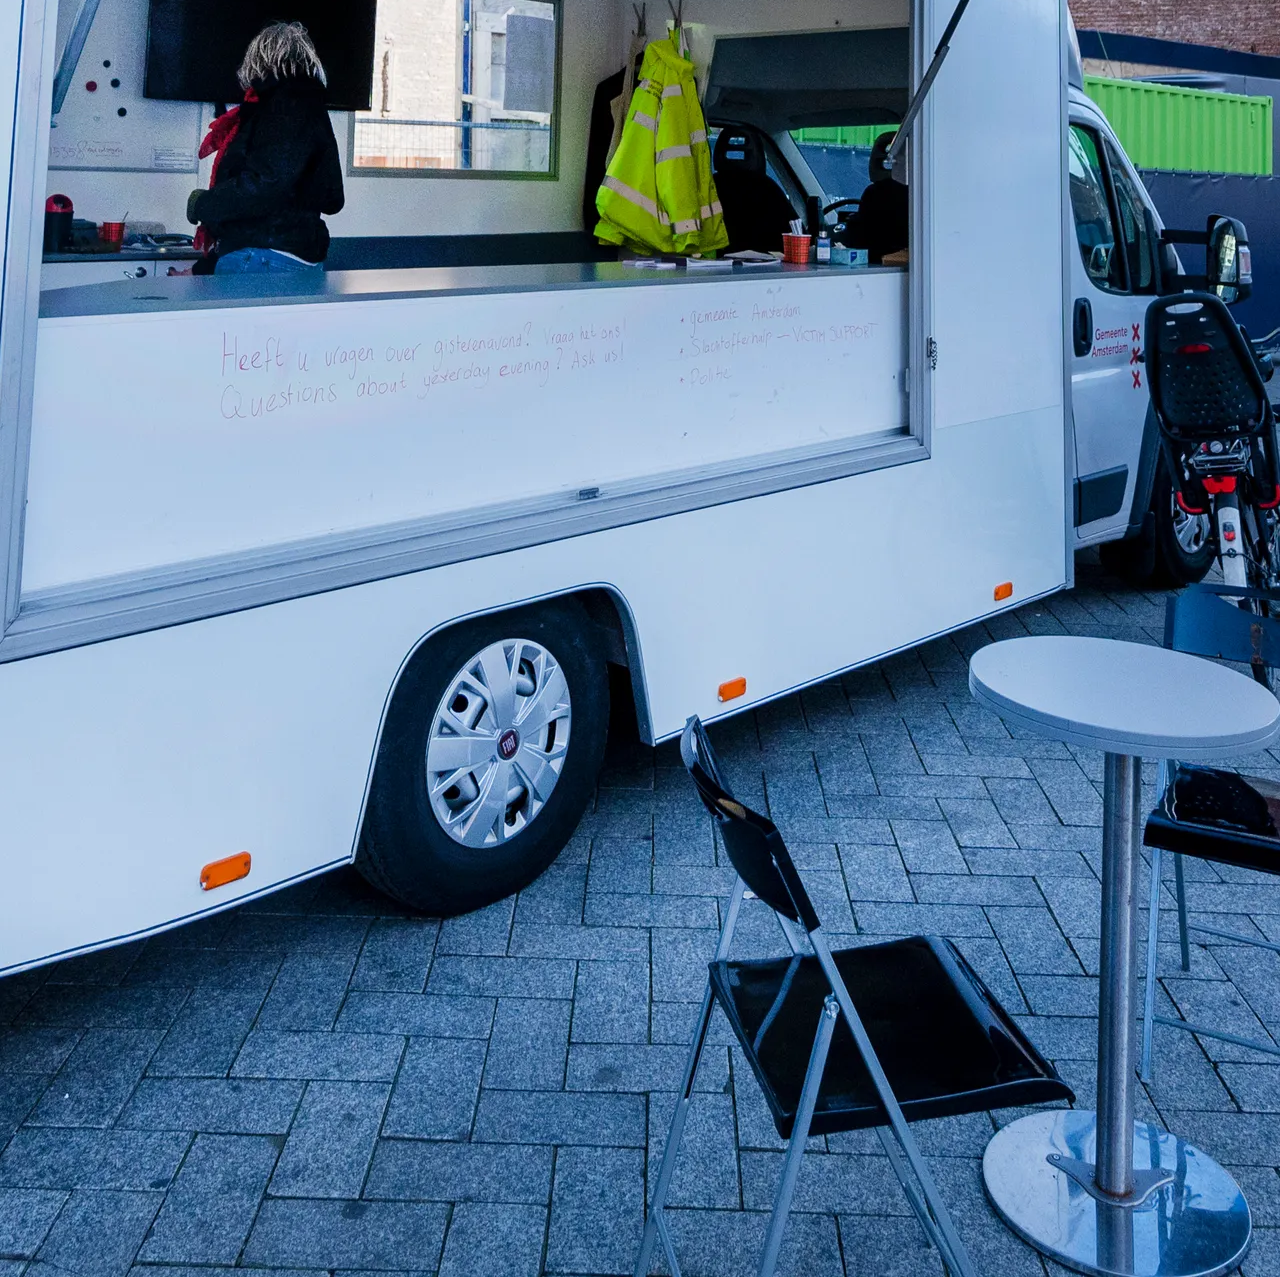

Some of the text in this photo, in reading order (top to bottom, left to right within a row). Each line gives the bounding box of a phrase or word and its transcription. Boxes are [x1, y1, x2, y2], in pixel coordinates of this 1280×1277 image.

[752, 303, 801, 322] Amsterdam
[829, 322, 879, 342] SUPPORT
[1094, 326, 1129, 341] Gemeente
[222, 331, 284, 376] Heeft
[299, 351, 309, 372] u
[325, 345, 375, 380] vragen
[386, 342, 422, 363] over
[543, 326, 574, 350] Vraag
[580, 324, 597, 340] het
[1091, 341, 1129, 358] Amsterdam
[220, 382, 338, 420] Questions
[356, 372, 408, 397] about
[417, 362, 490, 400] yesterday
[571, 350, 596, 370] Ask
[604, 340, 624, 363] us!
[502, 734, 516, 754] FIAT
